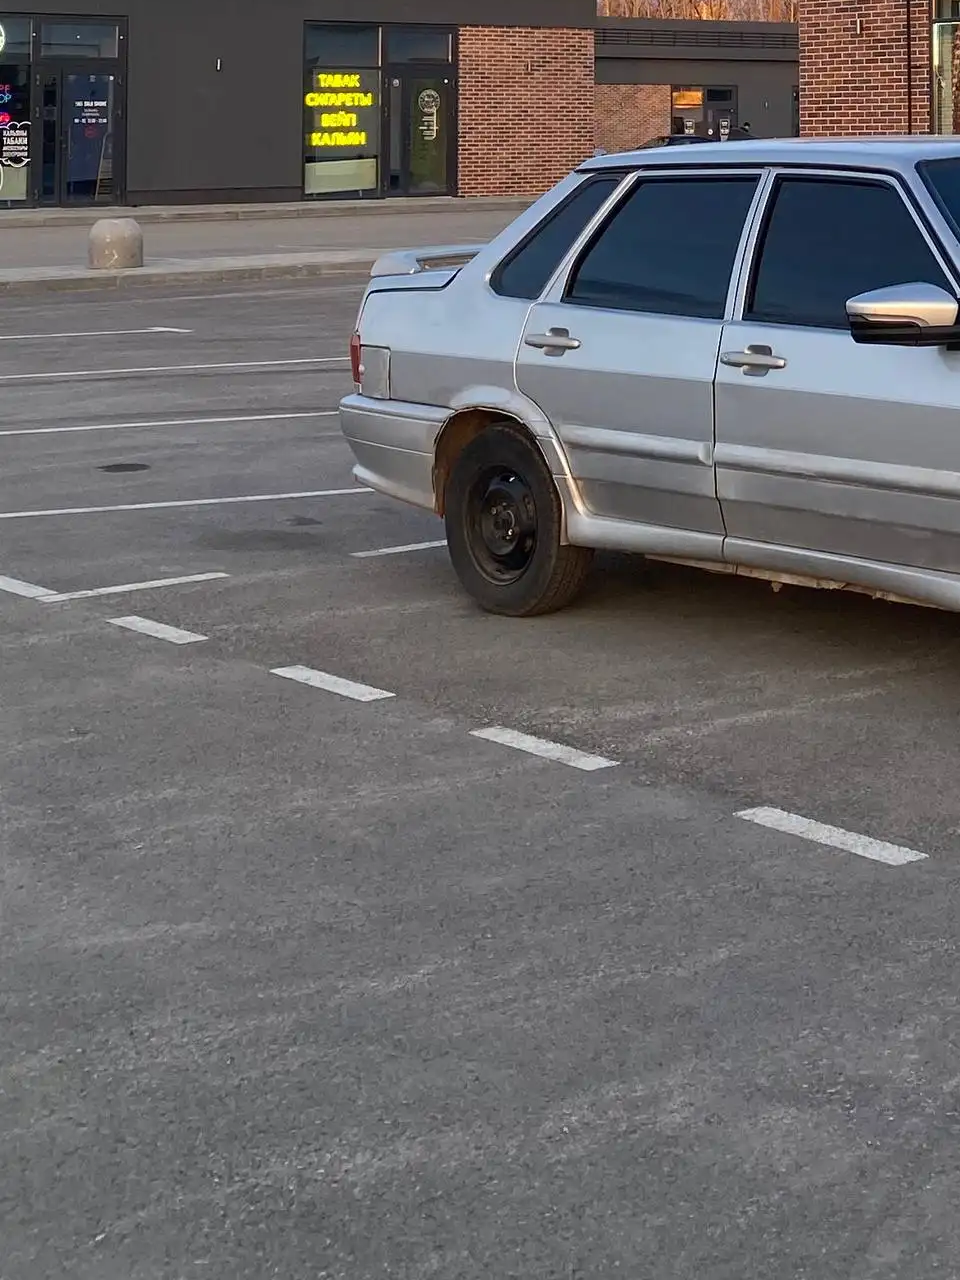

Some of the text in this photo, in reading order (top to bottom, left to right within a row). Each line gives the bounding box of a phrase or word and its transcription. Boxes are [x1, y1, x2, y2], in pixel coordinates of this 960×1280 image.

[318, 73, 361, 88] ТАБАК
[305, 92, 373, 107] СИГАРЕТЫ
[321, 110, 357, 127] ВЕЙП
[311, 131, 367, 146] КАЛЬЯН
